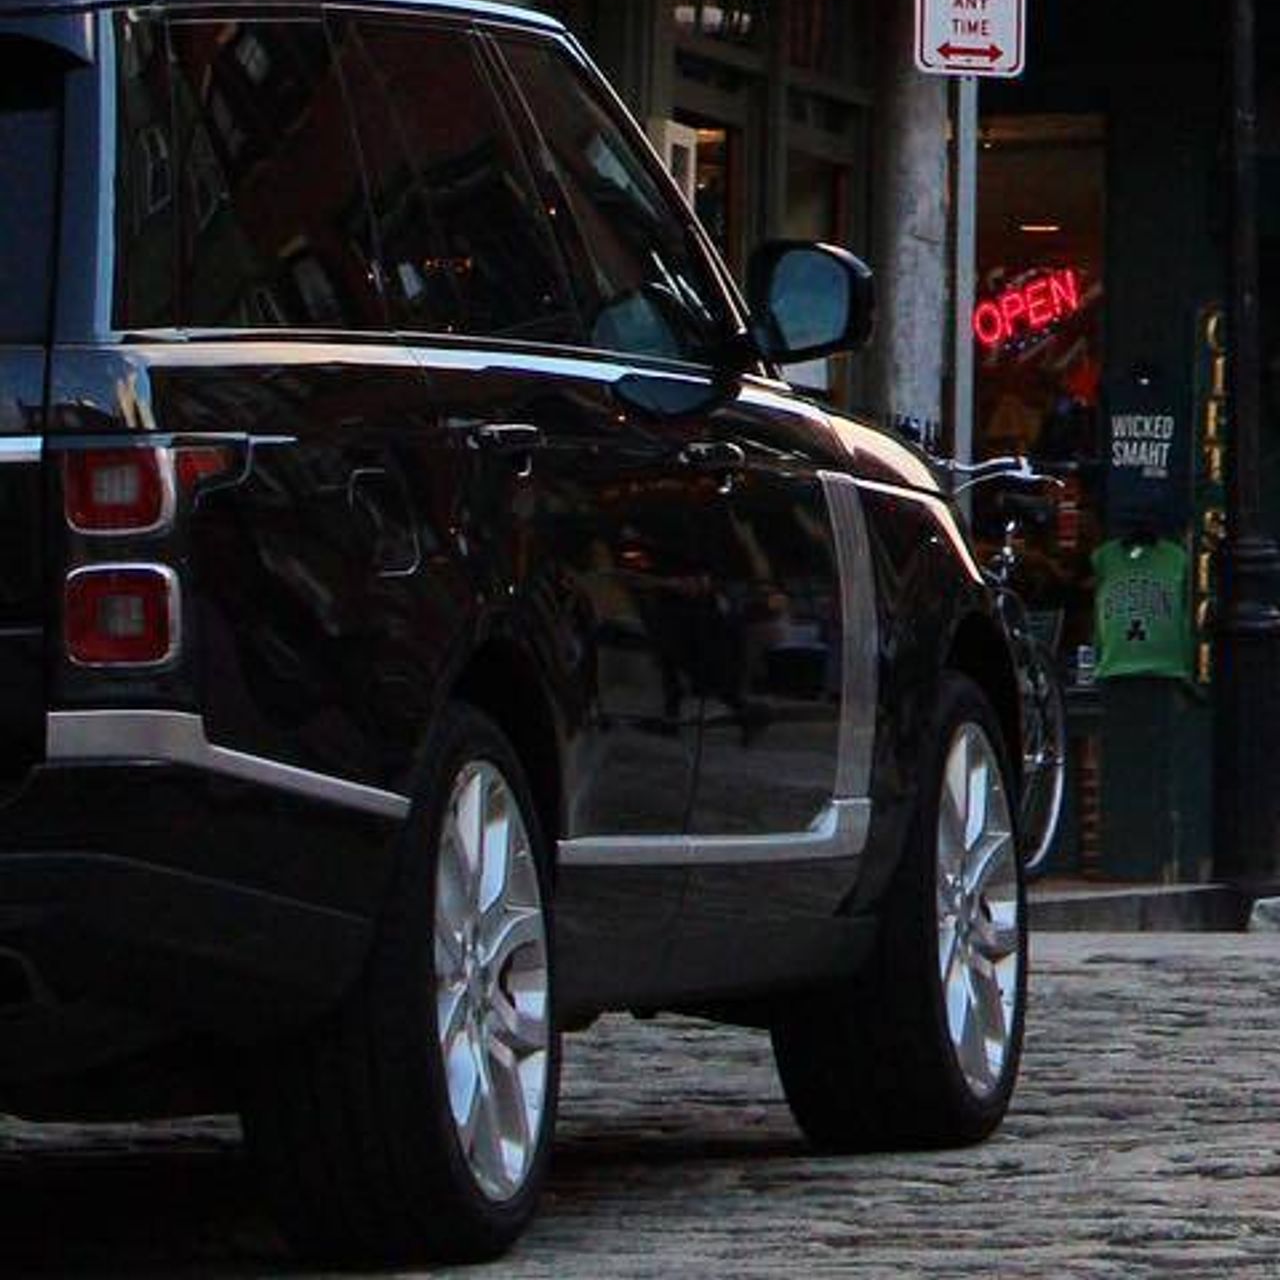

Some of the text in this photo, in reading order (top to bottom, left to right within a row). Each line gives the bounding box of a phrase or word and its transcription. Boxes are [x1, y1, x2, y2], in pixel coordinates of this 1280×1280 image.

[953, 19, 990, 36] TIME
[974, 269, 1079, 344] OPEN
[1111, 415, 1175, 439] WICKED
[1111, 443, 1169, 468] SMAHT
